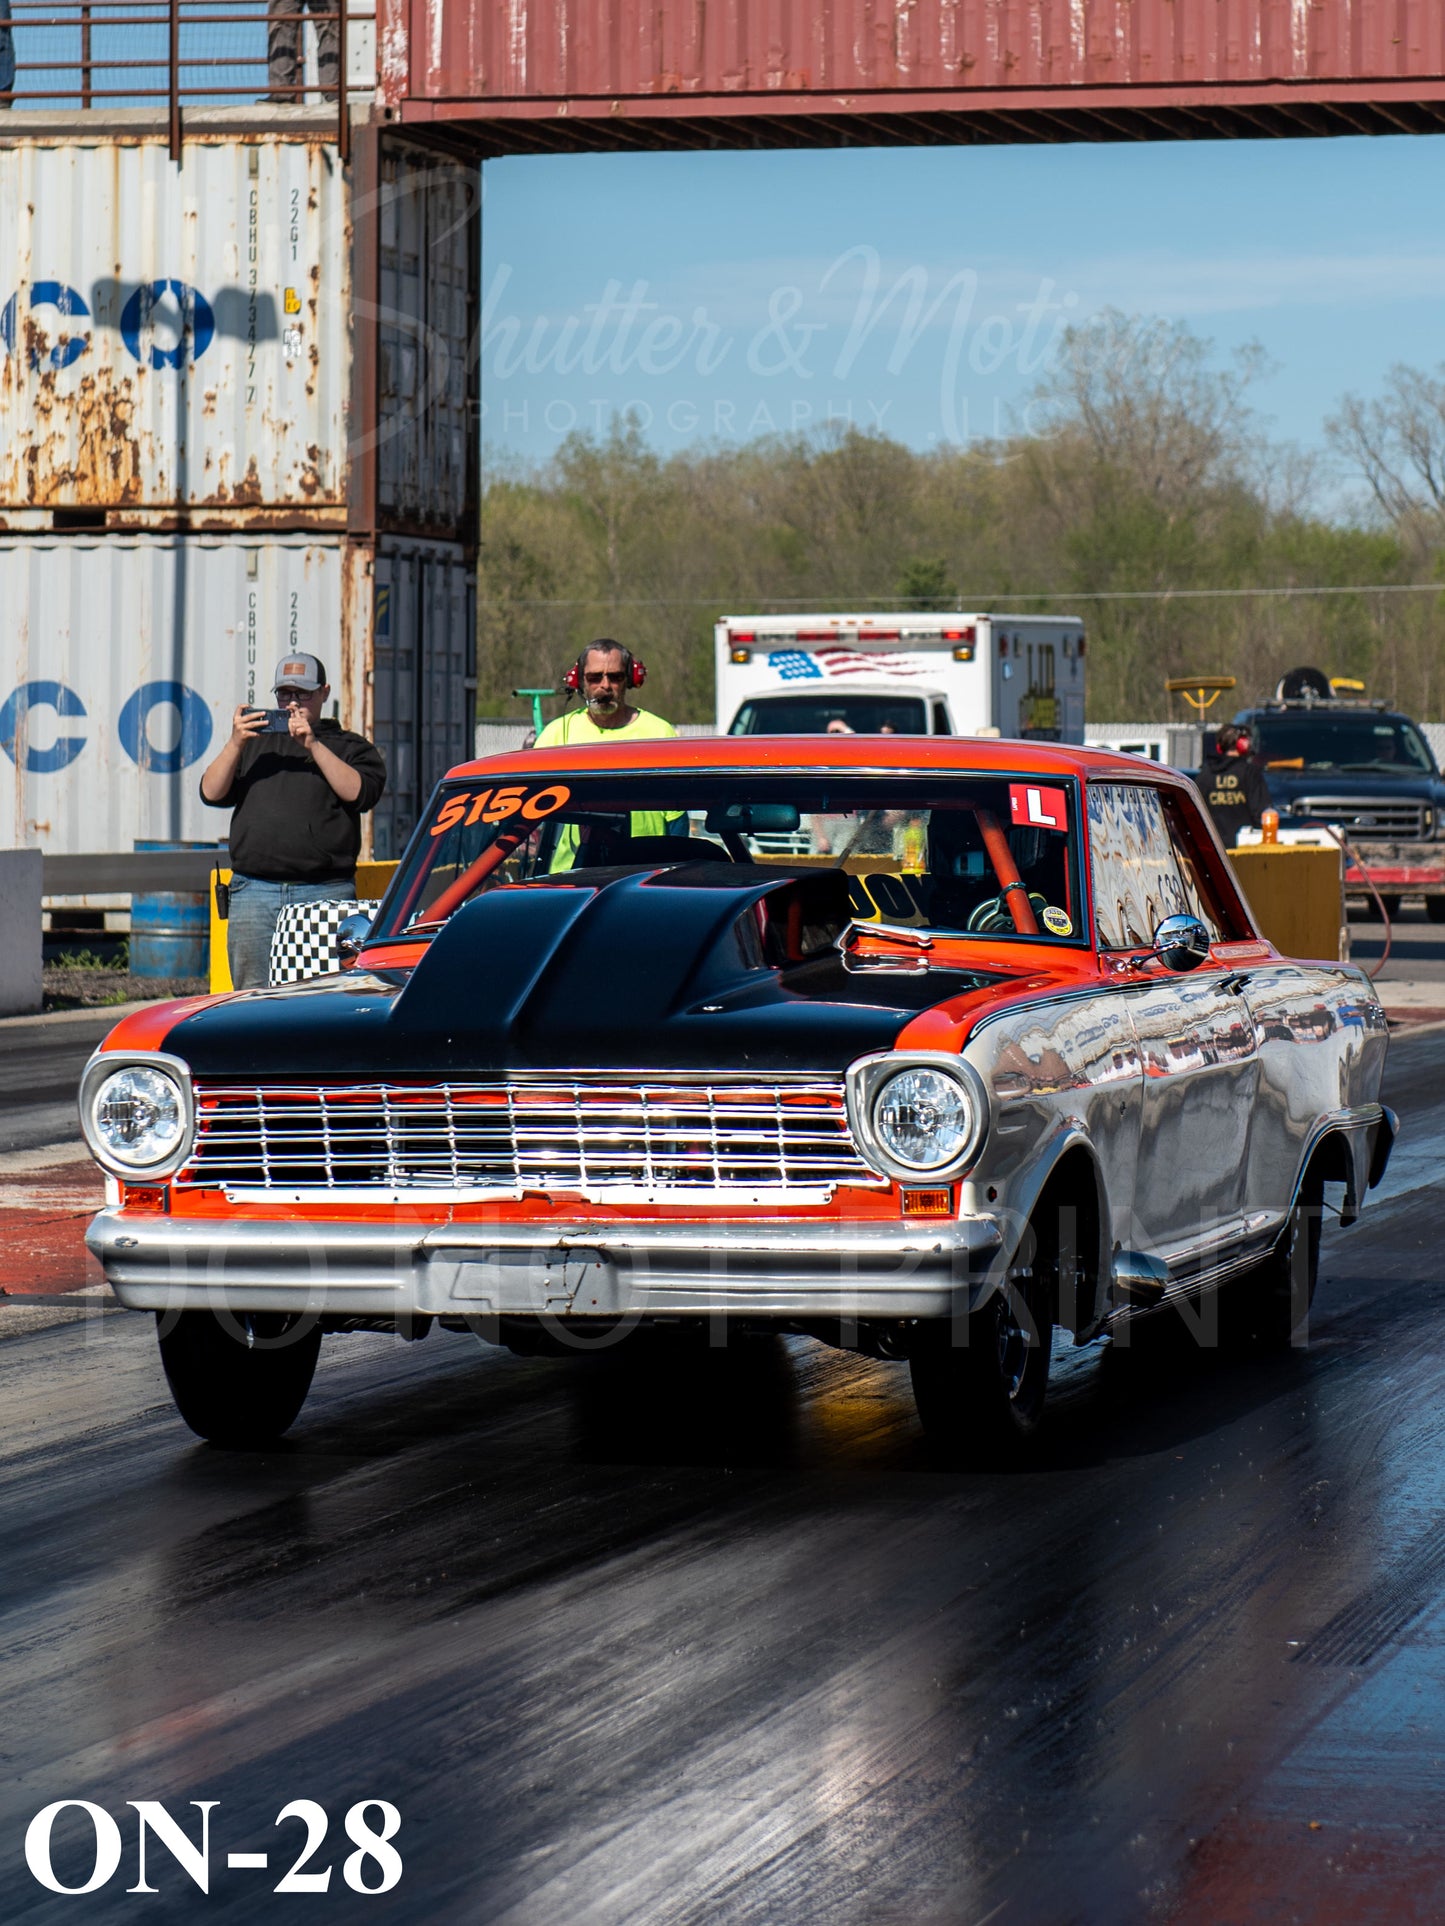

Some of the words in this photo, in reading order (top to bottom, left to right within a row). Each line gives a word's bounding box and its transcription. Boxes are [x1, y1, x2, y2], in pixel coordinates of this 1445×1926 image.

[249, 189, 257, 263] CBHU
[290, 188, 300, 261] 22G1
[248, 592, 256, 665] CBHU
[430, 785, 571, 836] 5150
[1026, 788, 1057, 826] L
